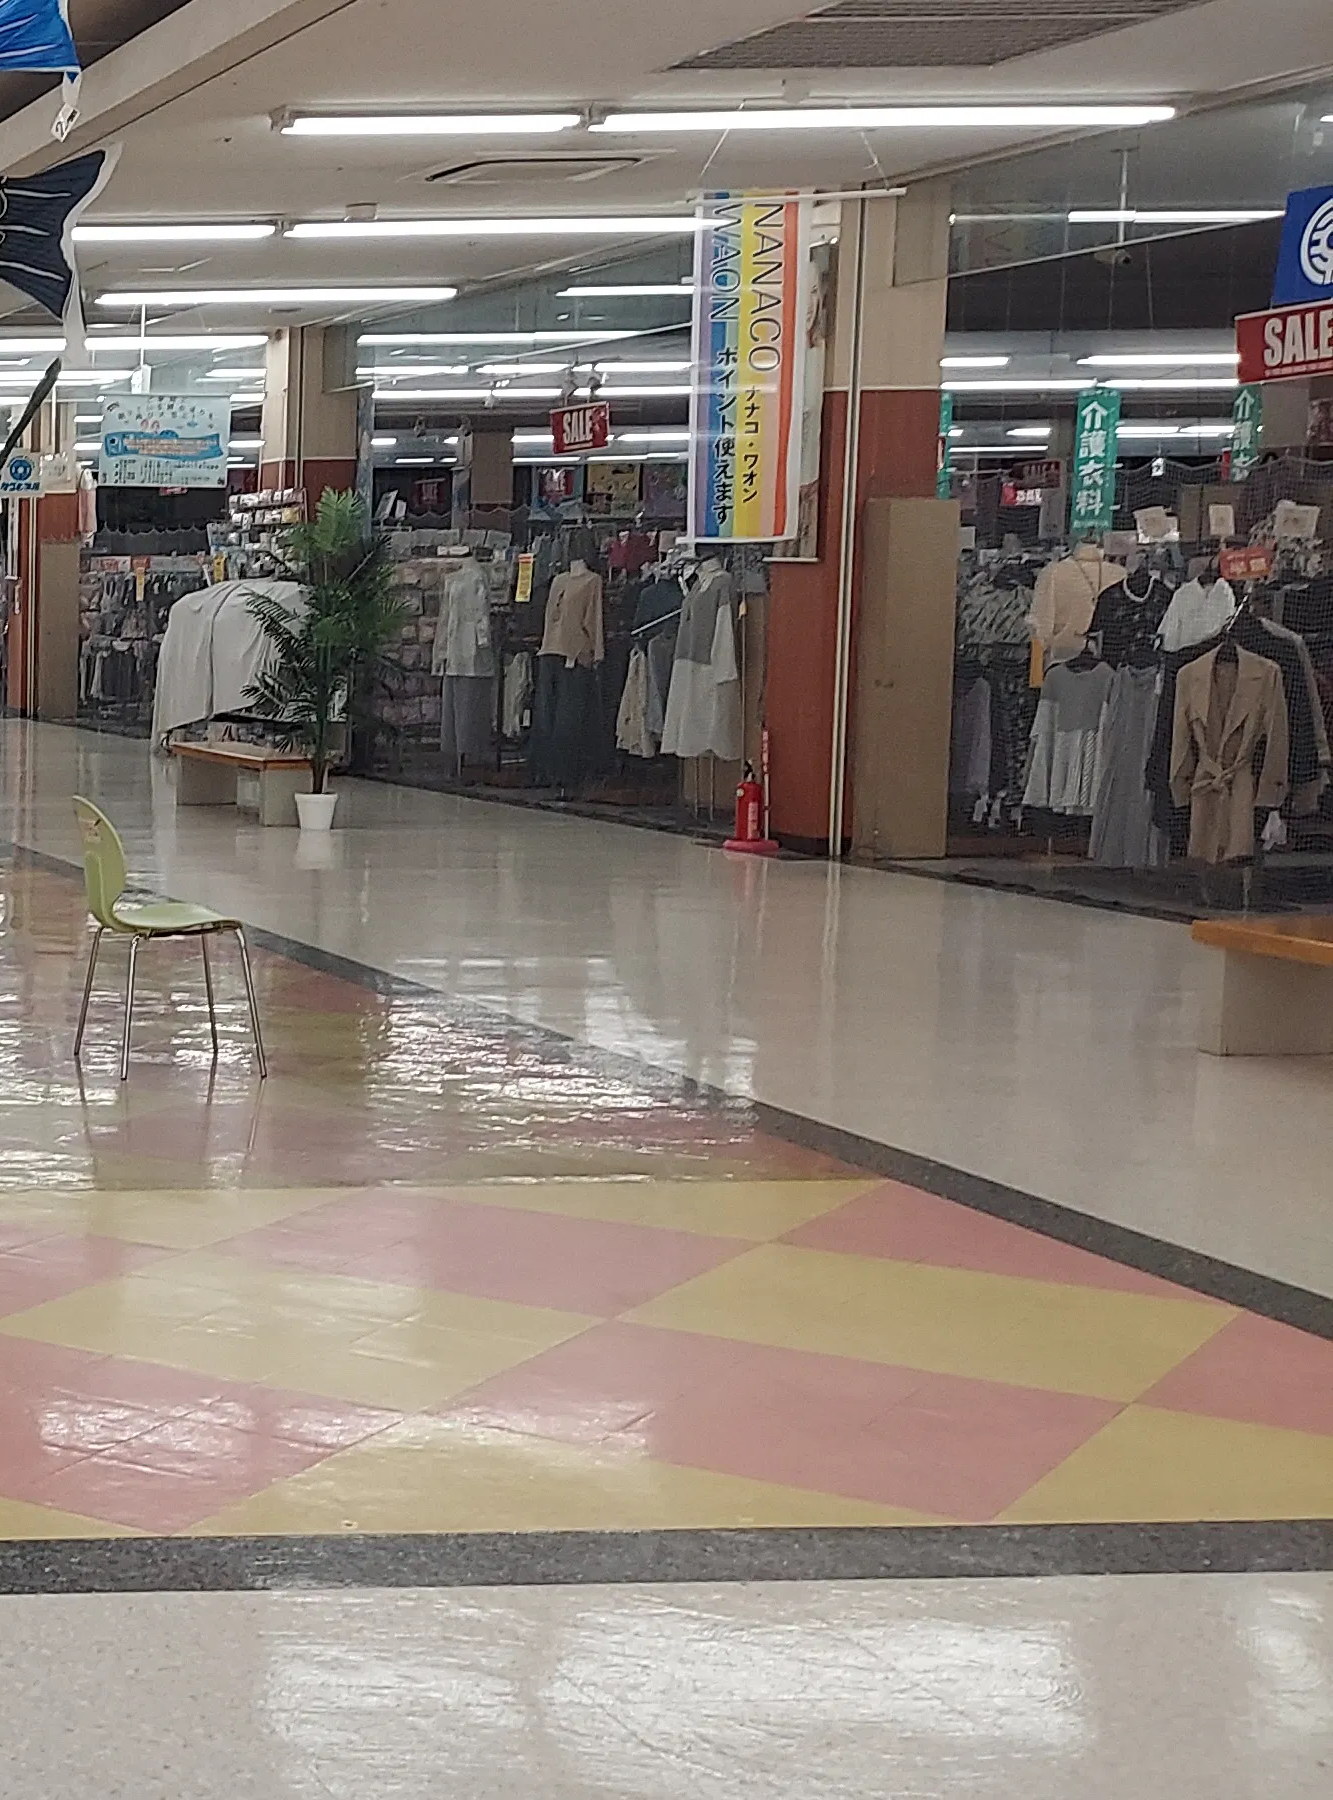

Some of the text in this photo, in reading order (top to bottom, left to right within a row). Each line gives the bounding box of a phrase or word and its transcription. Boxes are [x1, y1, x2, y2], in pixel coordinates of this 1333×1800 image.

[709, 203, 742, 525] WAON ポイント使えます
[742, 202, 784, 504] NANACO ナナコ・ワオン
[1264, 309, 1333, 367] SALE
[562, 408, 593, 445] SALE
[1076, 401, 1108, 516] 介護衣料
[1233, 389, 1255, 481] 介護衣
